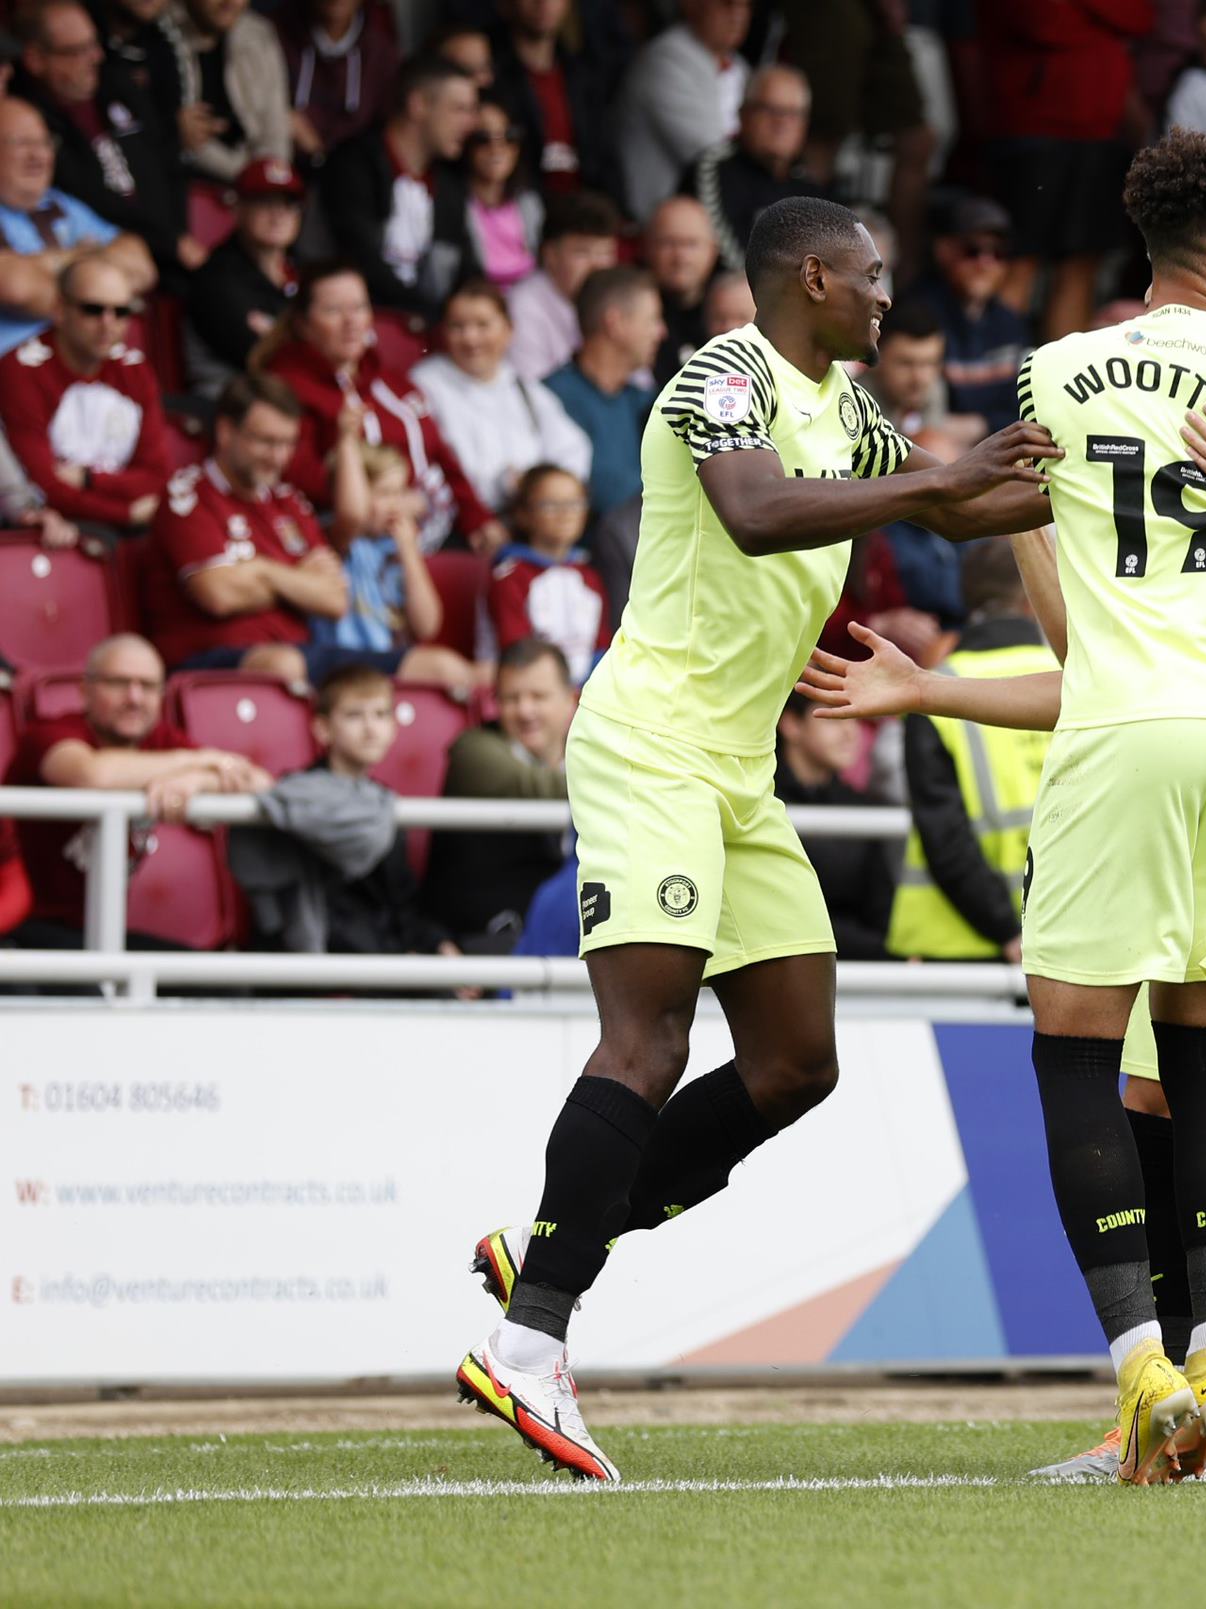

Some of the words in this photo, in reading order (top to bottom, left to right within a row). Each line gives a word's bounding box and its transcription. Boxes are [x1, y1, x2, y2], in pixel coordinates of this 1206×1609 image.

[728, 378, 746, 386] bet
[45, 1081, 122, 1112] 01604
[129, 1081, 221, 1112] 805646
[56, 1174, 399, 1206] www.venturecontracts.co.uk
[1096, 1208, 1146, 1233] COUNTY
[40, 1271, 390, 1307] info@venturecontracts.co.uk
